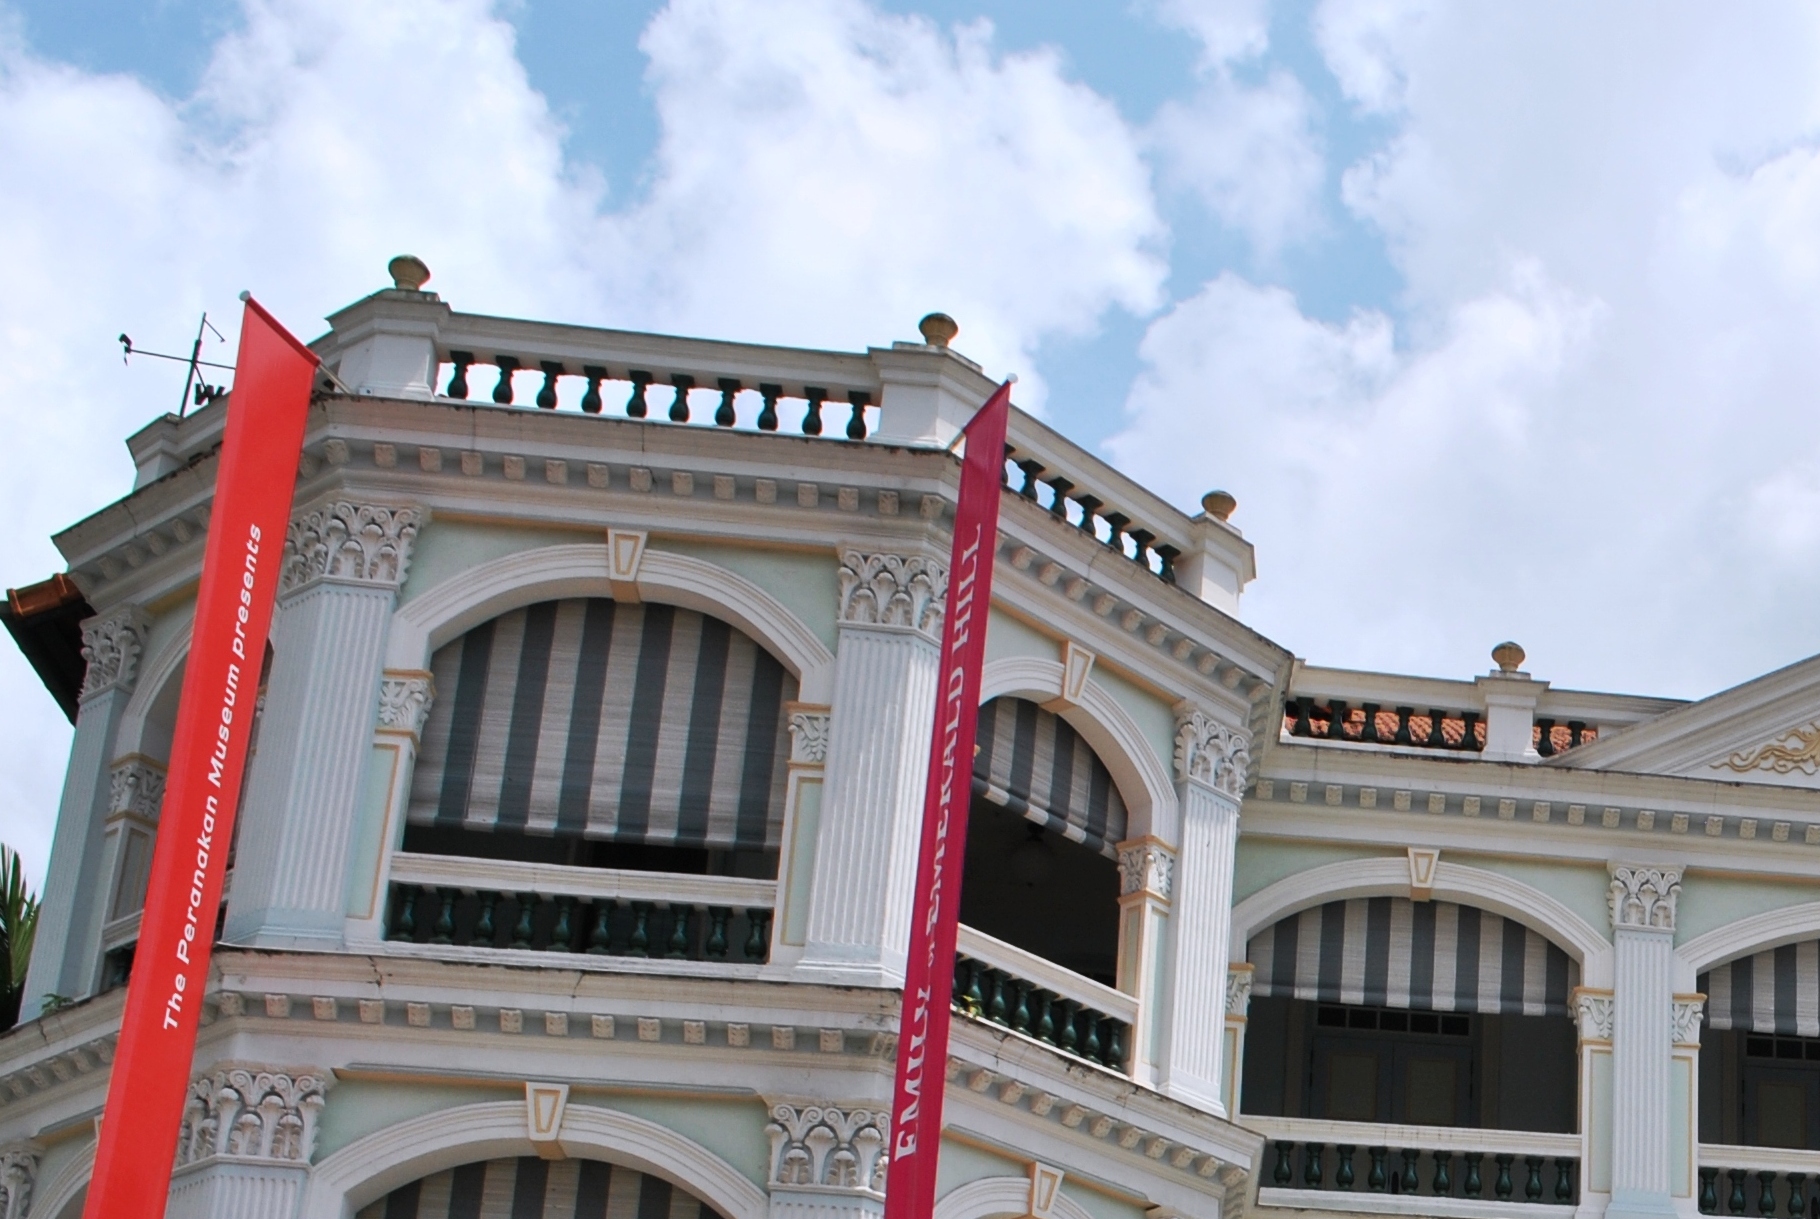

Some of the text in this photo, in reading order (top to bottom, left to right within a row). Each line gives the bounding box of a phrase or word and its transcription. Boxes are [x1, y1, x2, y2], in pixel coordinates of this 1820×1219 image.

[163, 523, 262, 1030] The Peranakan Museum presents
[894, 984, 931, 1163] EMILY
[951, 522, 981, 656] HILL
